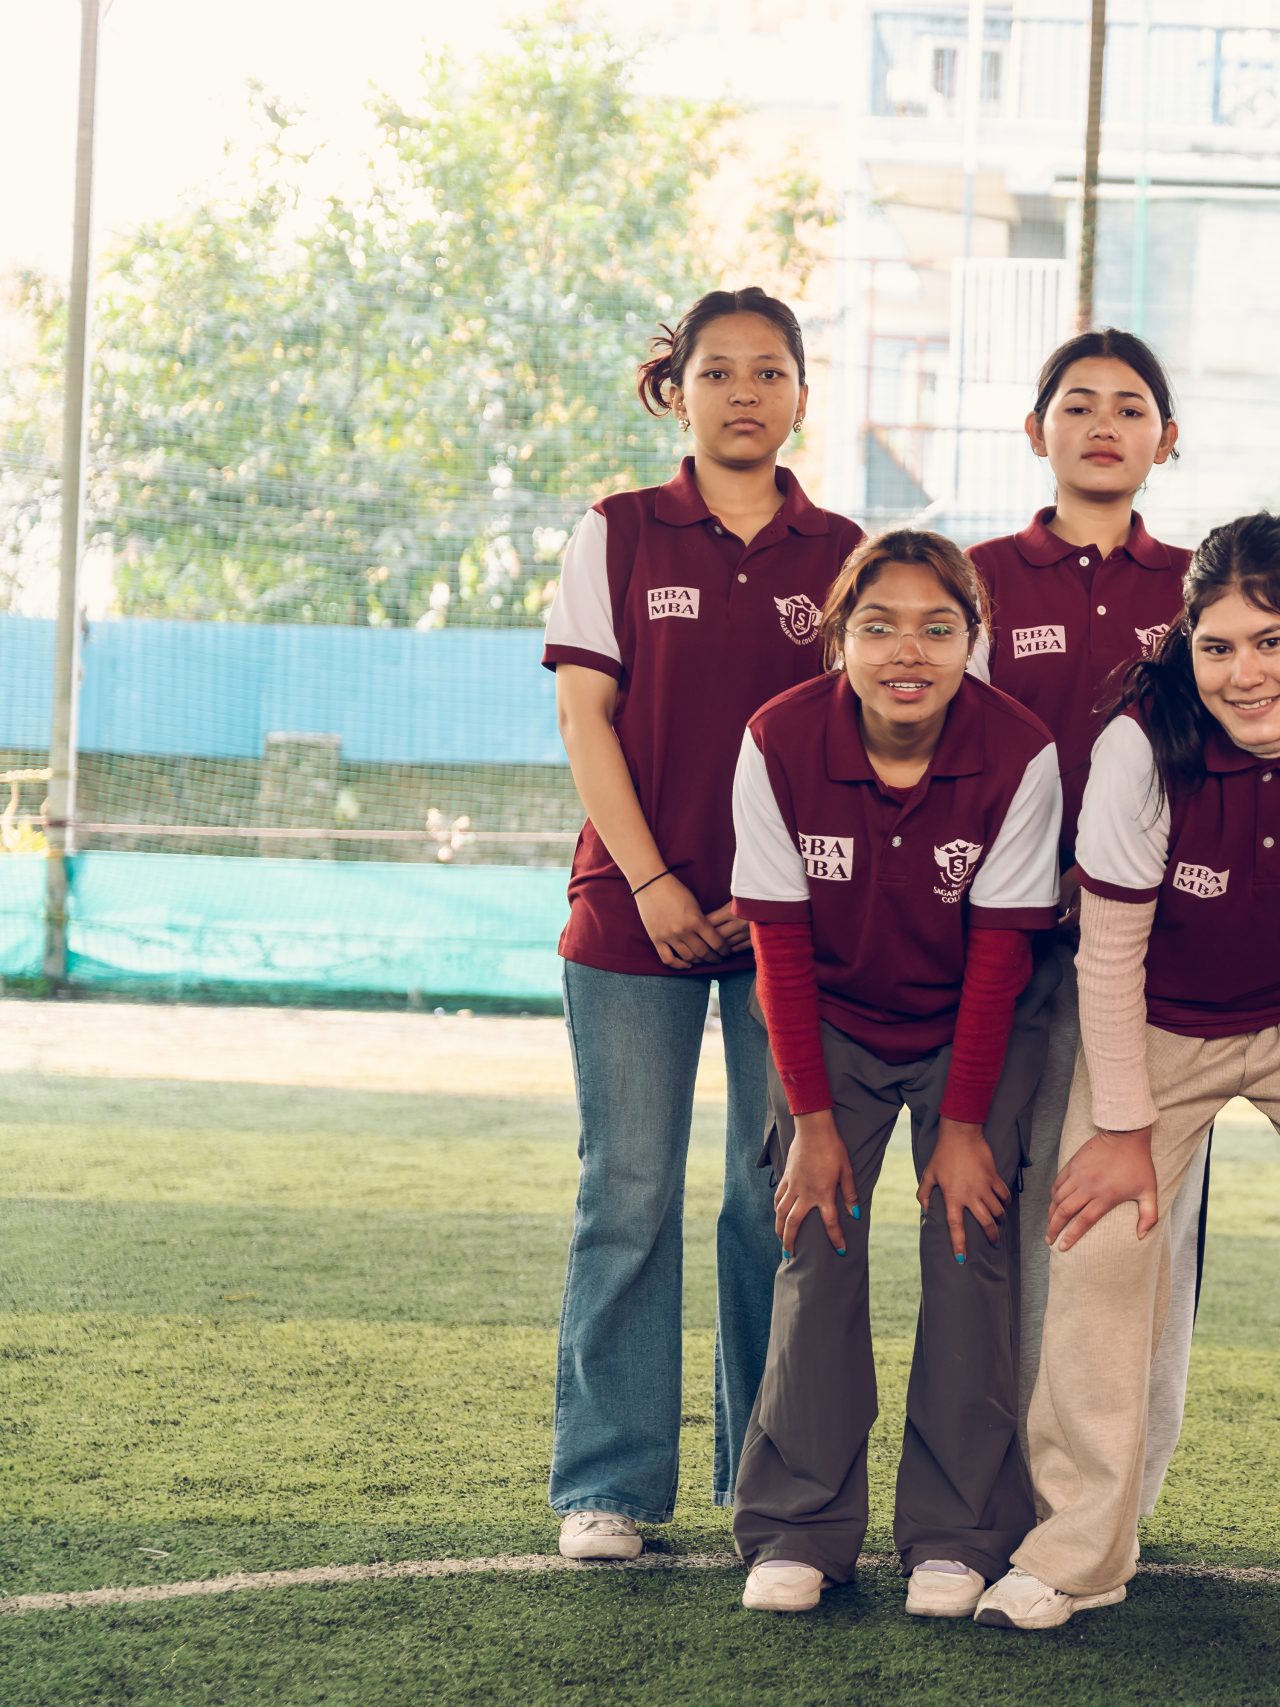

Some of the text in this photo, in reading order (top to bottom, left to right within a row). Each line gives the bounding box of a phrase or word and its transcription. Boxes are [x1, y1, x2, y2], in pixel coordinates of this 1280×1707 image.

[650, 589, 691, 602] BBA
[650, 602, 695, 616] MBA
[1015, 628, 1057, 641] BBA
[1016, 639, 1062, 655] MBA
[1180, 865, 1222, 885] BBA
[1176, 877, 1224, 896] MBA
